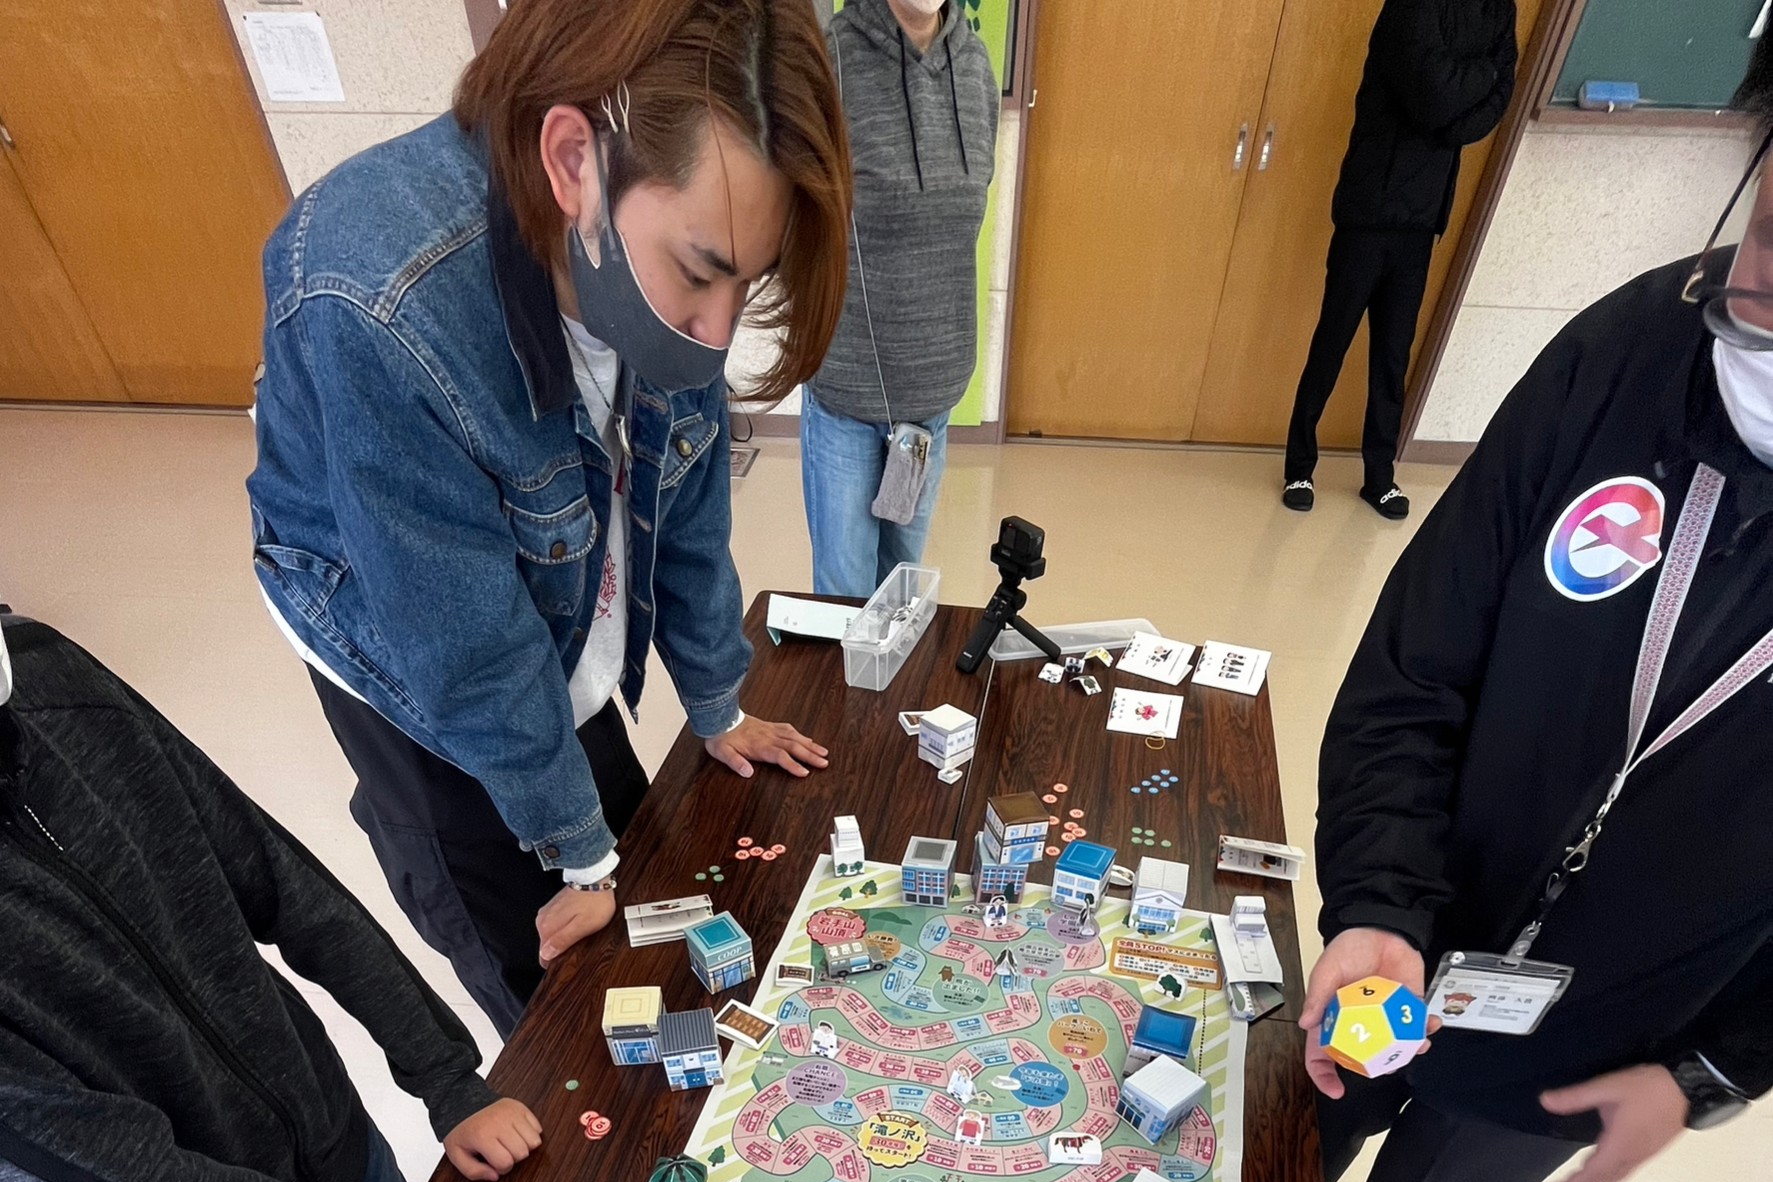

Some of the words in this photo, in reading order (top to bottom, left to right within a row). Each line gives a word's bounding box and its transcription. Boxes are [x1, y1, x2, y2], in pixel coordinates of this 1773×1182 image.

[819, 917, 856, 930] 岩手山
[821, 927, 847, 938] 山頂
[1401, 1005, 1412, 1023] 3
[1350, 1023, 1372, 1043] 2
[887, 1114, 909, 1123] START
[870, 1122, 921, 1142] 「滝ノ沢」
